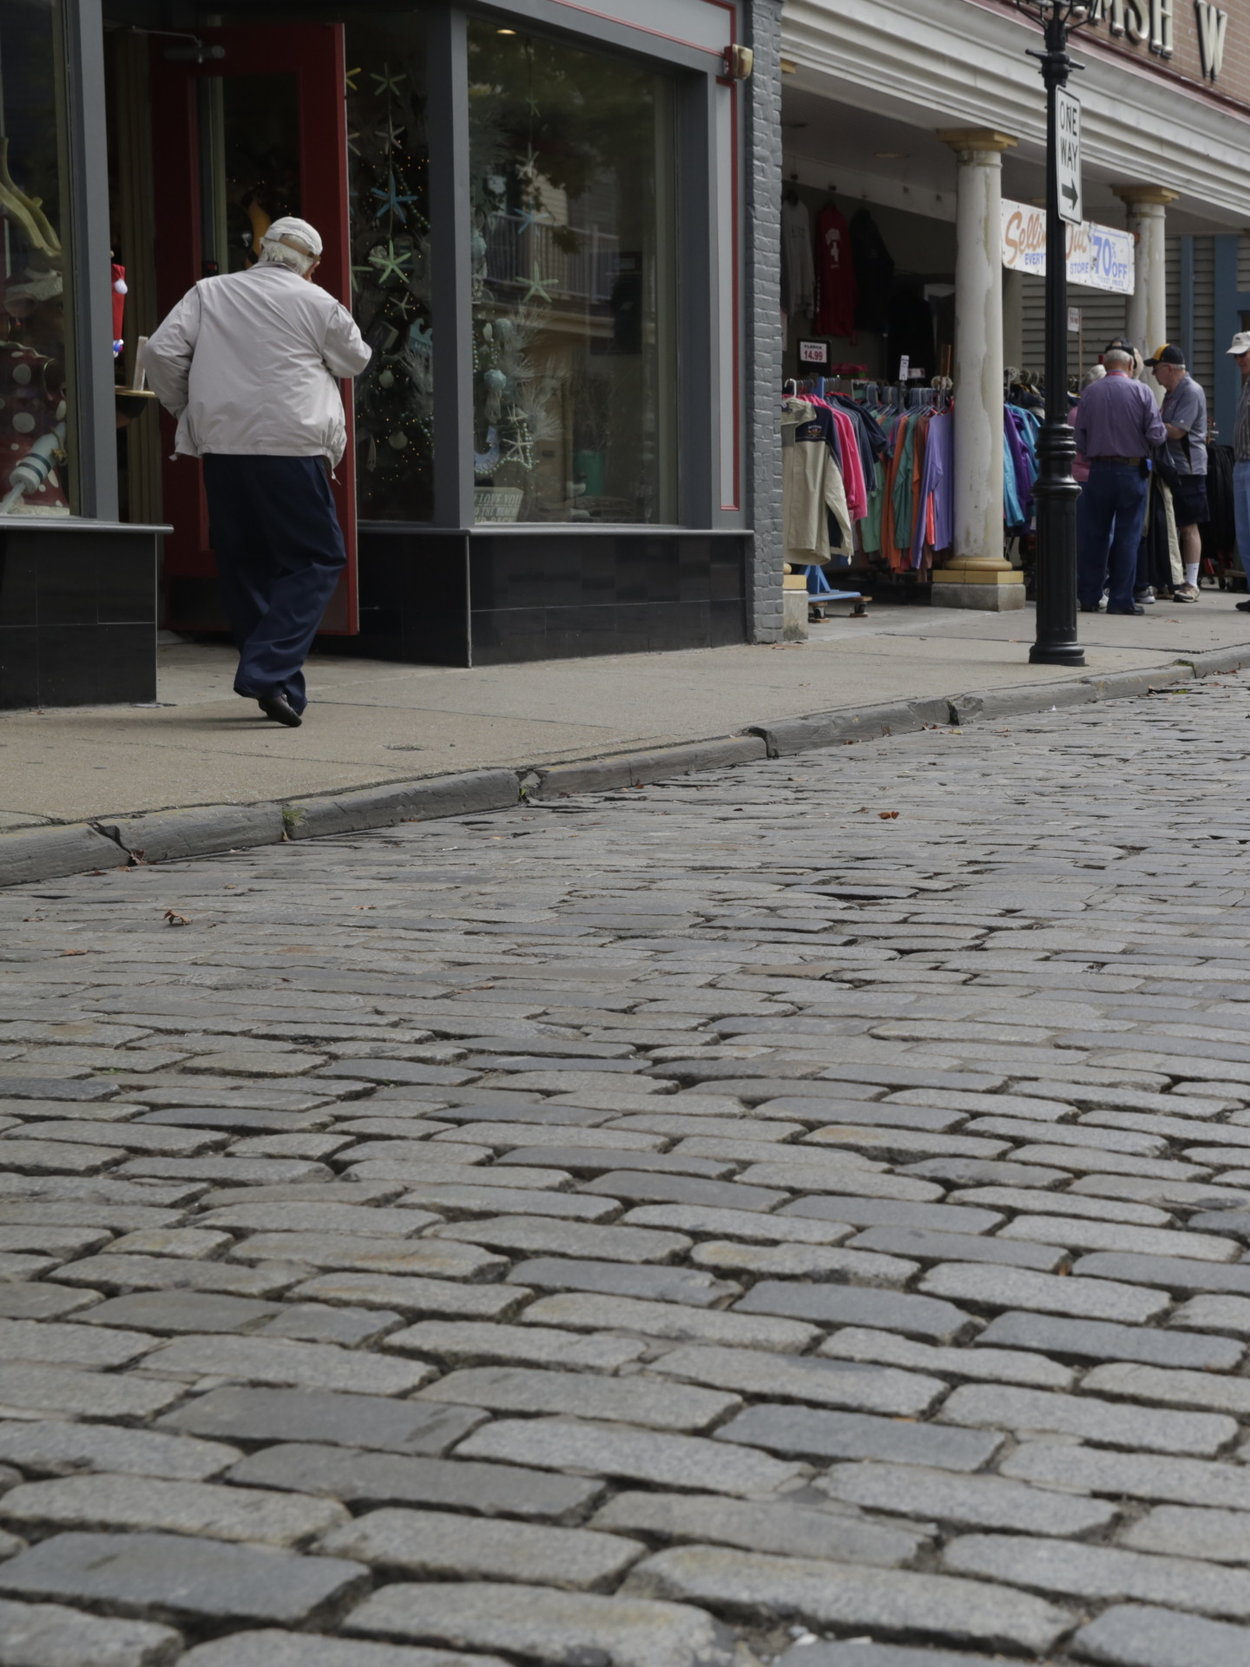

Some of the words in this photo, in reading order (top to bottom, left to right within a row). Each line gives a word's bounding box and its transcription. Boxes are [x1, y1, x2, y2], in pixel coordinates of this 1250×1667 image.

[1060, 100, 1077, 136] ONE
[1060, 136, 1078, 172] WAY
[1024, 252, 1046, 265] EVERY
[1069, 262, 1089, 275] STORE
[1111, 262, 1127, 279] OFF
[804, 351, 823, 361] 14.99
